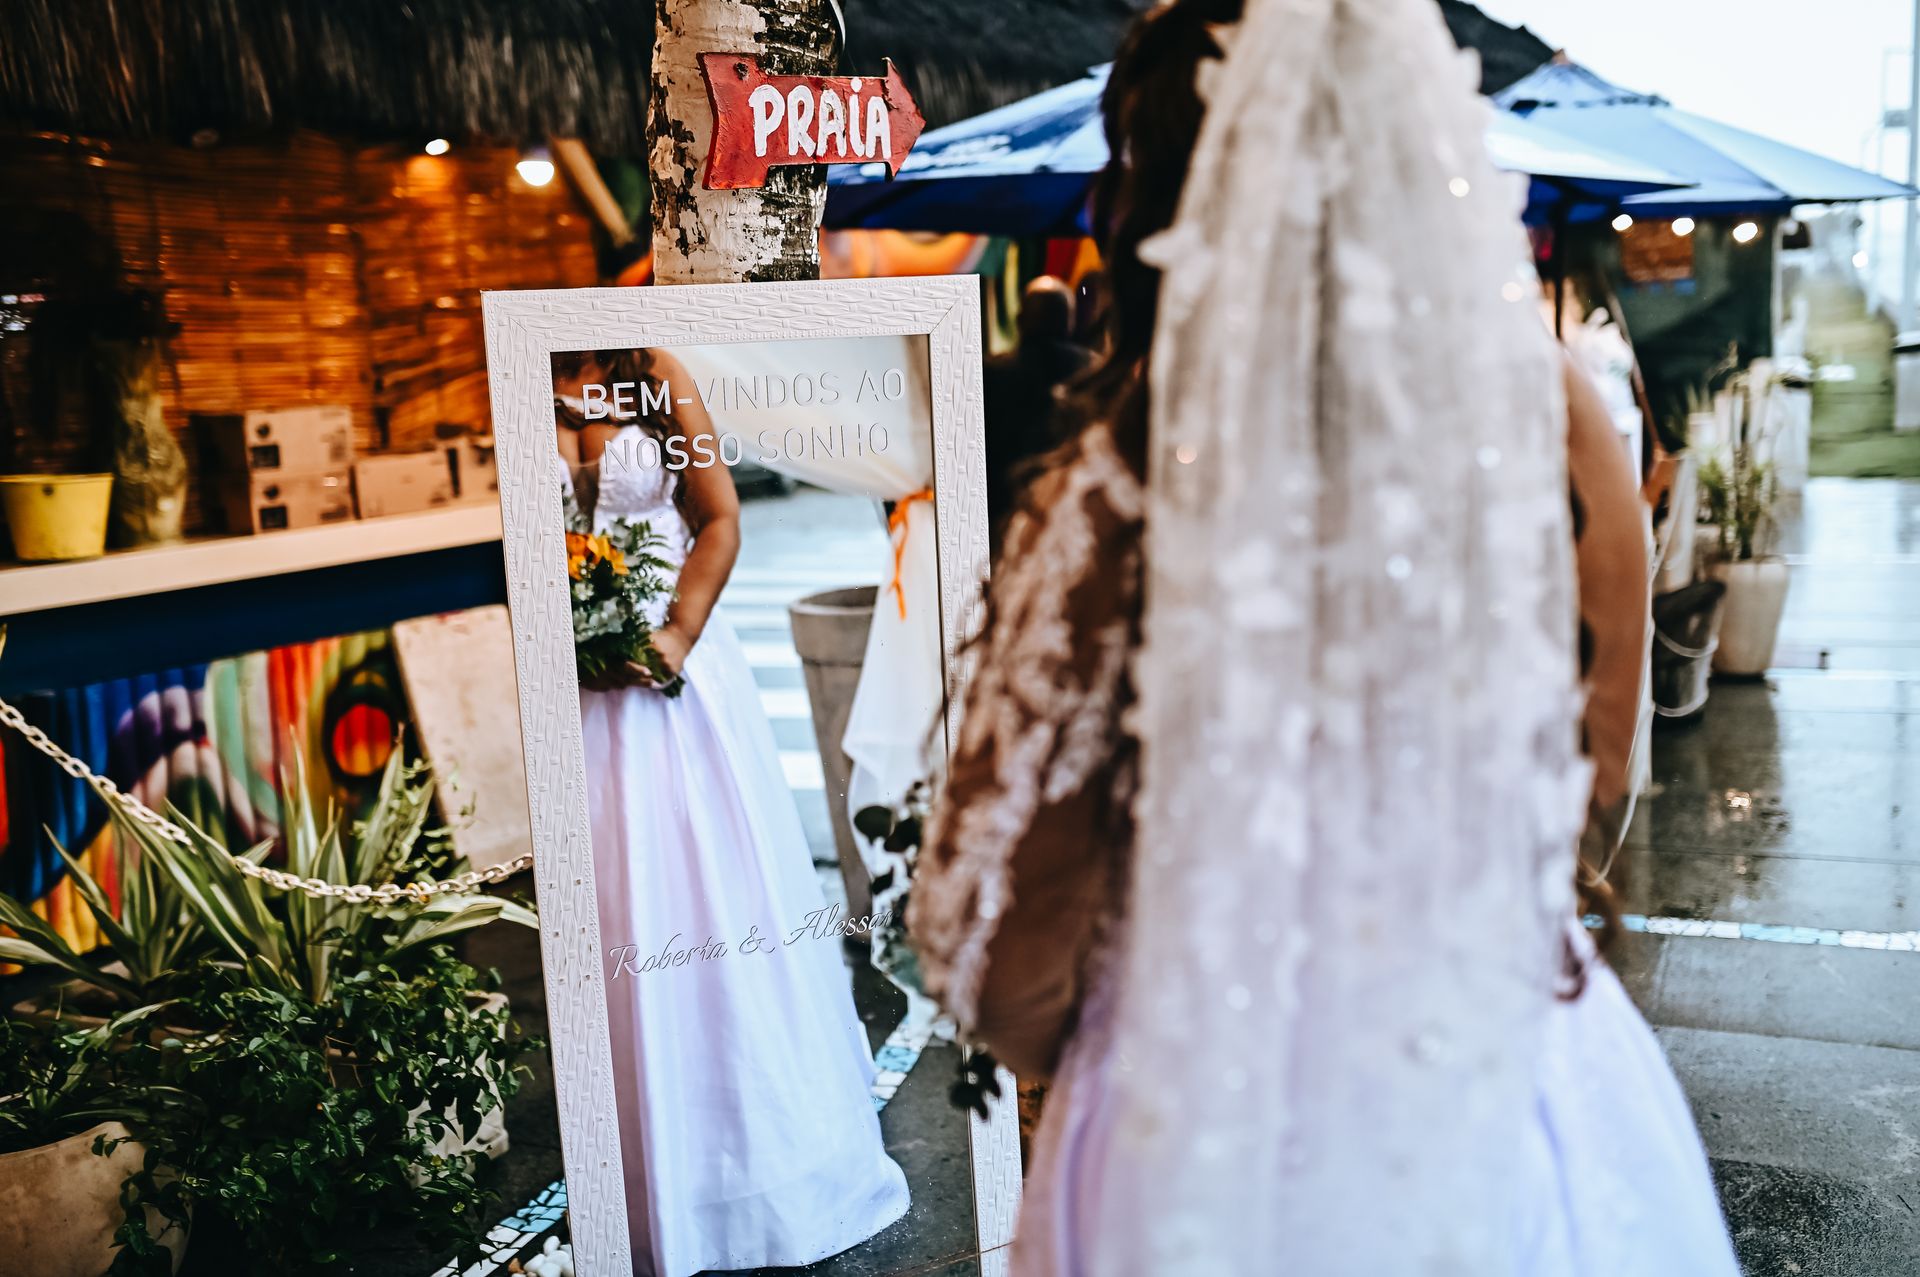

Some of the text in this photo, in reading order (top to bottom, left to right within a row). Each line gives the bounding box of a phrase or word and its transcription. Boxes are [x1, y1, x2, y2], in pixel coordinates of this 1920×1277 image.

[582, 367, 905, 420] BEM-VINDOS AO
[604, 422, 889, 475] NOSSO SONHO
[609, 932, 727, 980] Roberta
[738, 925, 776, 954] &
